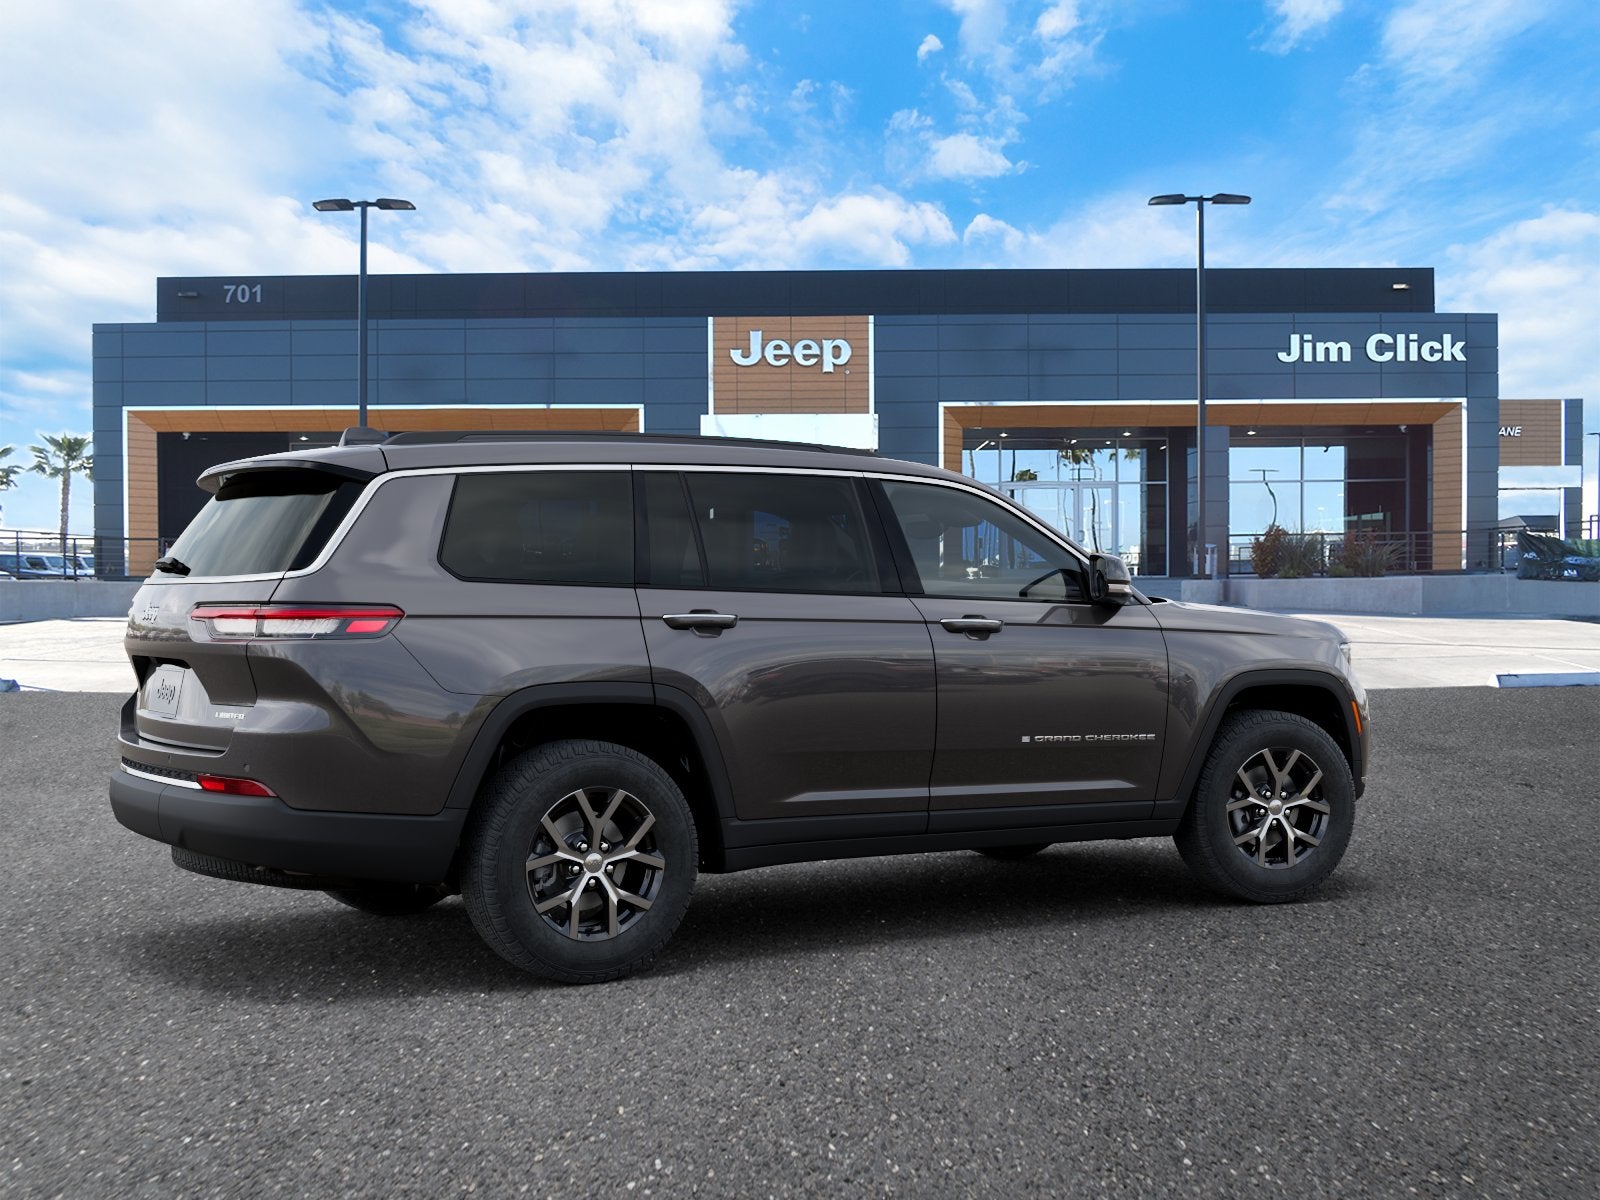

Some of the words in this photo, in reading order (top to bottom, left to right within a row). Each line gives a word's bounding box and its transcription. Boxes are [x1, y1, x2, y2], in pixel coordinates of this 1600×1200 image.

[223, 284, 263, 304] 701
[729, 330, 852, 374] Jeep
[1277, 333, 1352, 363] Jim
[1365, 333, 1467, 363] Click
[1084, 733, 1156, 741] CHEROKEE
